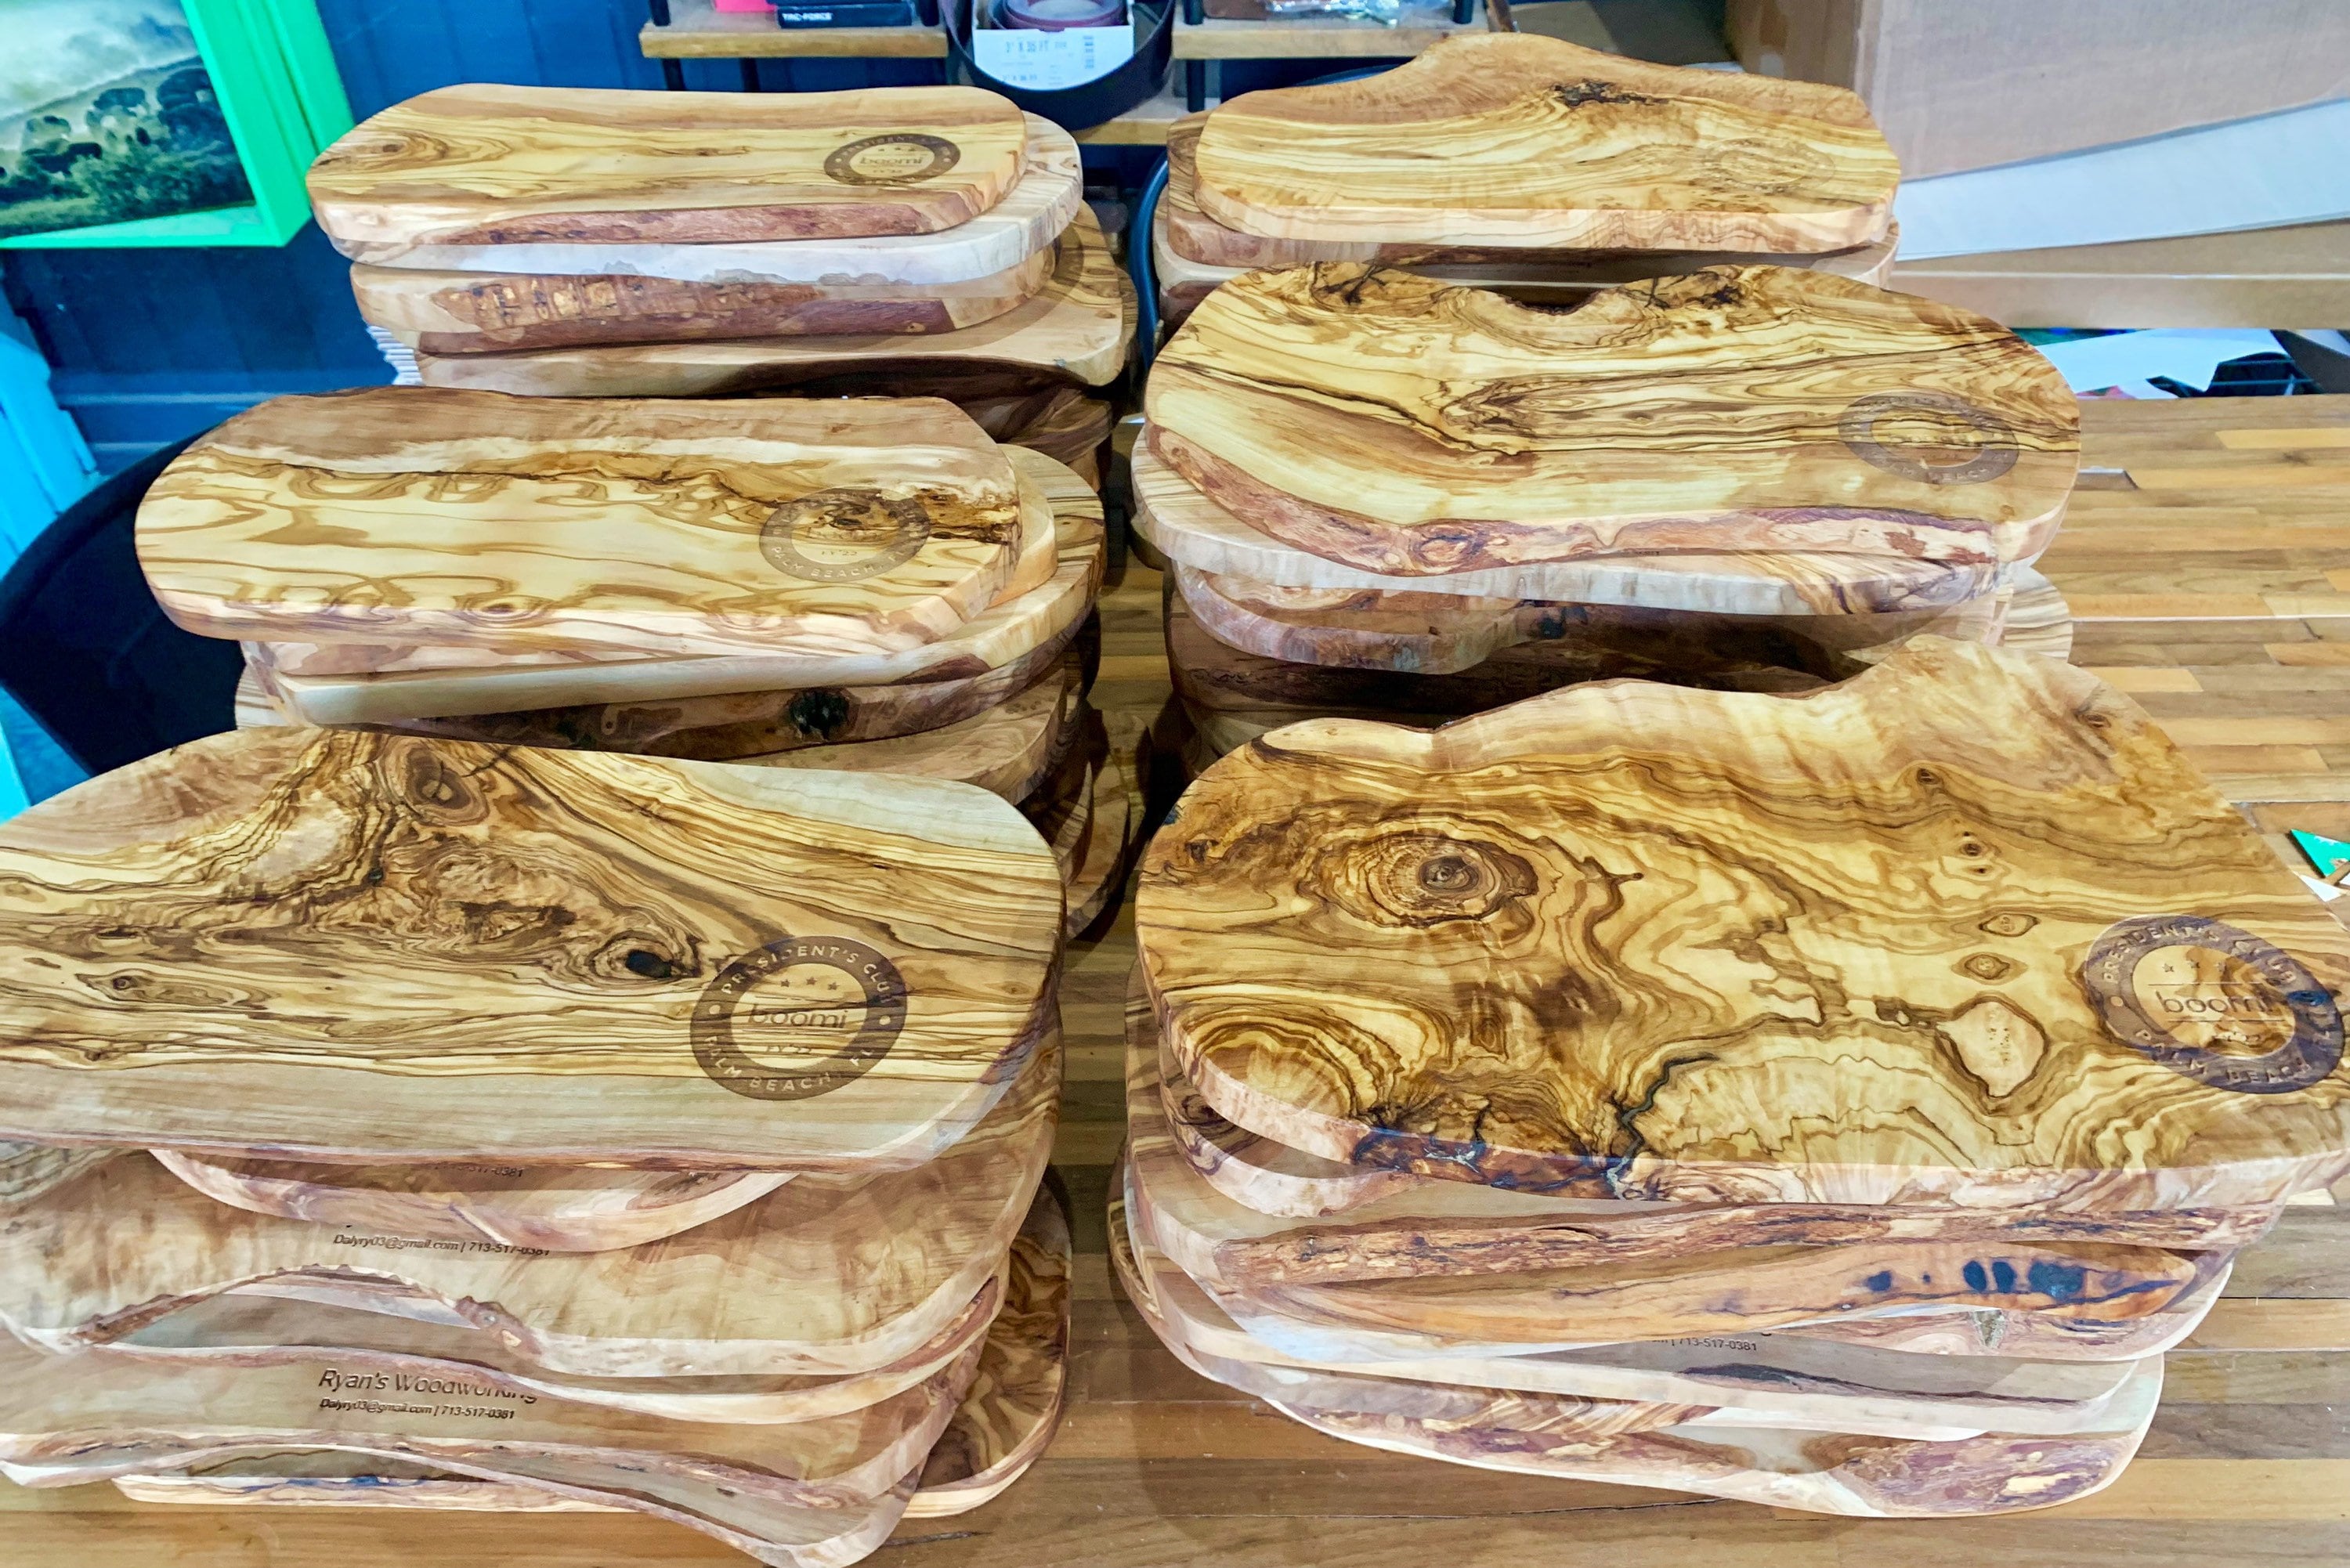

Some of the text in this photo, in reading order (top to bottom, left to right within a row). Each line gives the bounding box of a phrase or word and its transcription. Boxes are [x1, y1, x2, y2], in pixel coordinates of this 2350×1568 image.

[721, 945, 859, 995] PRESIDENT'S
[748, 1003, 849, 1029] boomi
[319, 1368, 389, 1393] Ryan's
